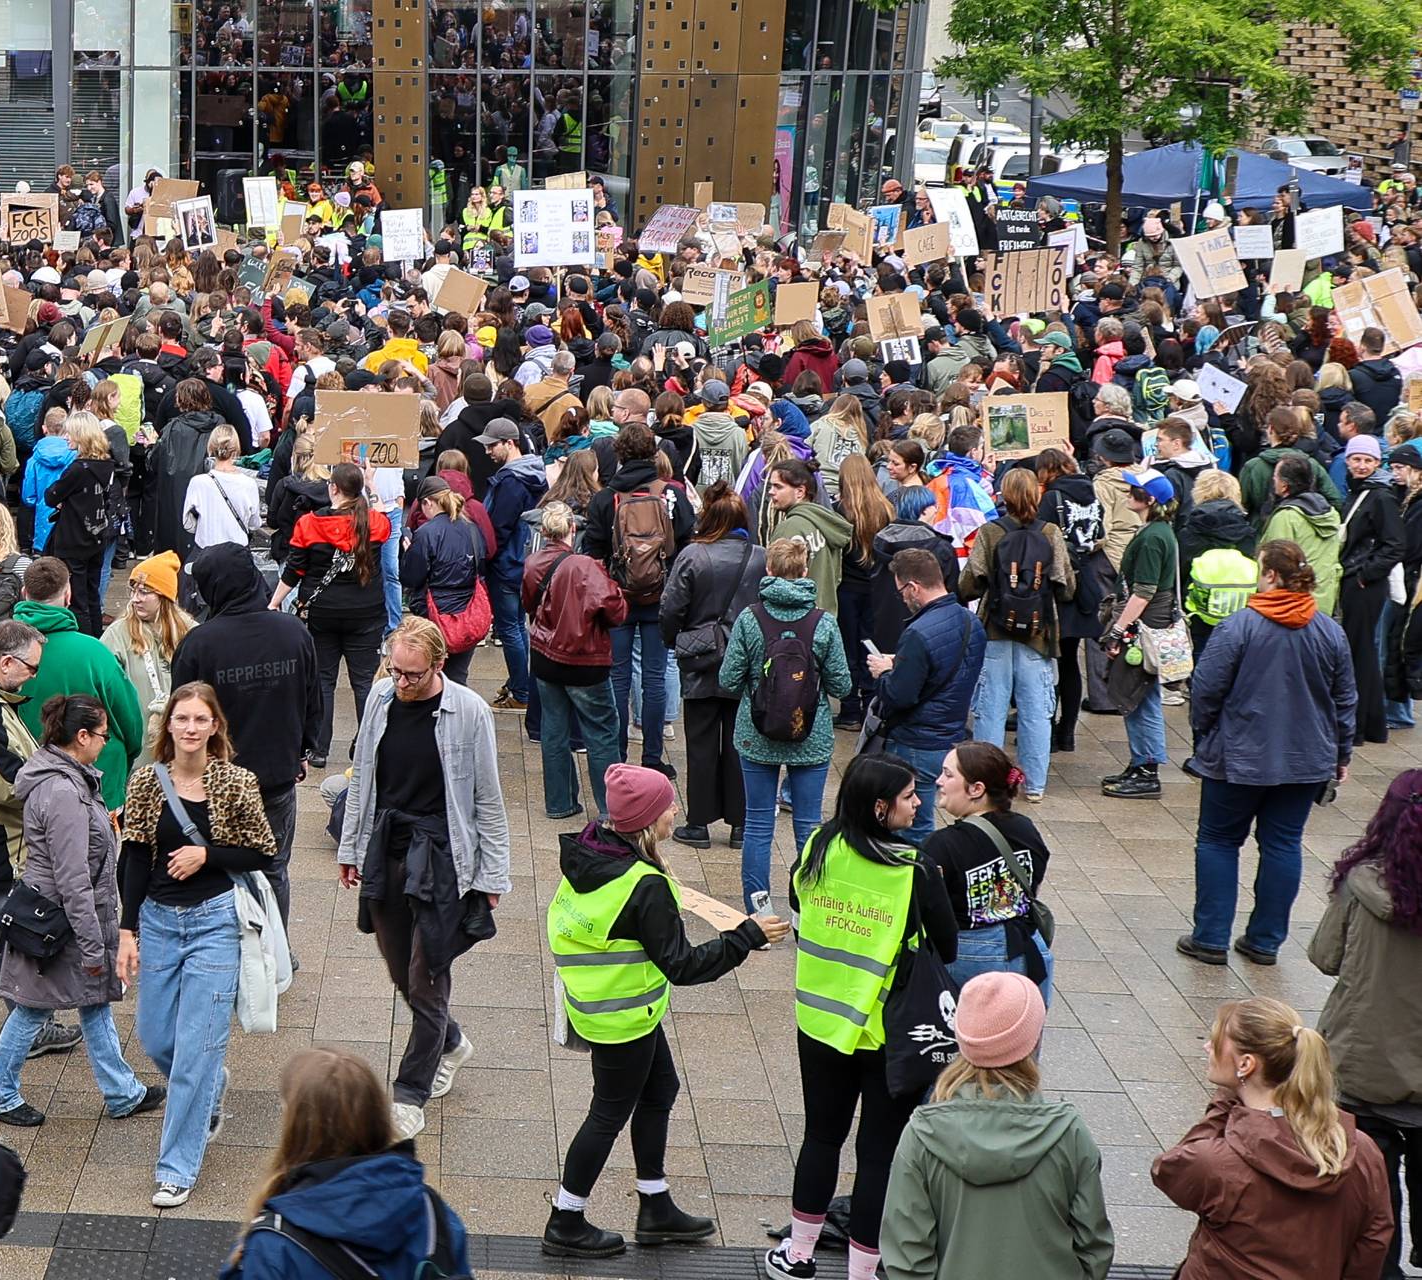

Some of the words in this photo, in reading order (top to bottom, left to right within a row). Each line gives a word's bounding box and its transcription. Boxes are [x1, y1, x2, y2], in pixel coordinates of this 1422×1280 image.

[12, 211, 48, 228] FCK
[996, 209, 1038, 221] ARTGERECHT
[12, 226, 49, 242] ZOOS
[918, 236, 936, 252] CAGE
[998, 240, 1035, 251] FREIHEIT
[991, 252, 1004, 312] FCK
[1050, 247, 1065, 306] ZOO
[216, 658, 298, 685] REPRESENT
[809, 892, 844, 913] Unflätig
[847, 901, 854, 913] &
[856, 903, 894, 928] Auffällig
[825, 915, 872, 938] #FCKZoos
[931, 1051, 946, 1063] SEA
